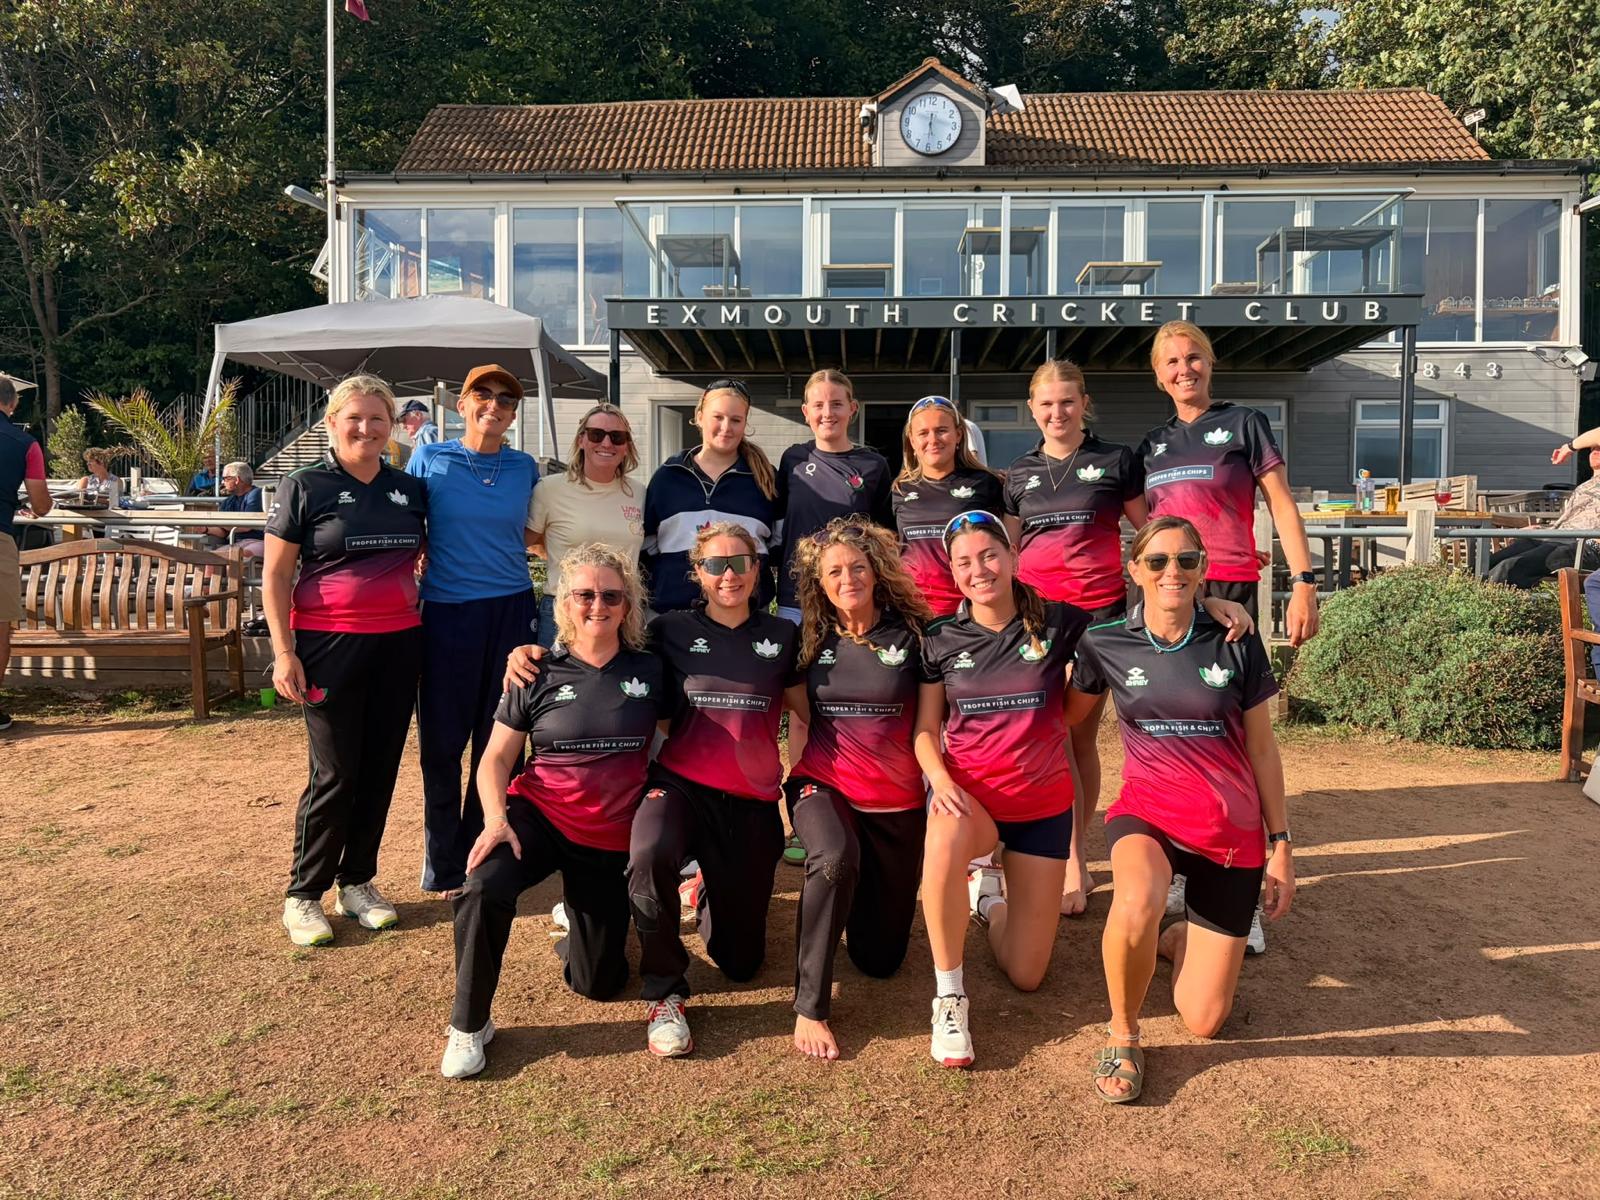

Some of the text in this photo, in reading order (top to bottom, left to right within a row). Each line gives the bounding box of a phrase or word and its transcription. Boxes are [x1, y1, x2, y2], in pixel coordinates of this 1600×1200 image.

[920, 99, 926, 108] 11
[929, 97, 937, 105] 12
[943, 101, 946, 109] 1
[909, 106, 916, 115] 10
[949, 110, 955, 119] 2
[905, 117, 910, 127] 9
[951, 122, 957, 130] 3
[906, 130, 912, 138] 8
[946, 133, 951, 141] 4
[916, 139, 921, 147] 7
[937, 141, 942, 149] 5
[925, 143, 931, 152] 6
[647, 301, 1380, 324] EXMOUTH CRICKET CLUB
[1392, 362, 1498, 378] 1843
[746, 699, 766, 707] CHIPS
[1017, 697, 1040, 705] CHIPS
[1197, 724, 1220, 732] CHIPS
